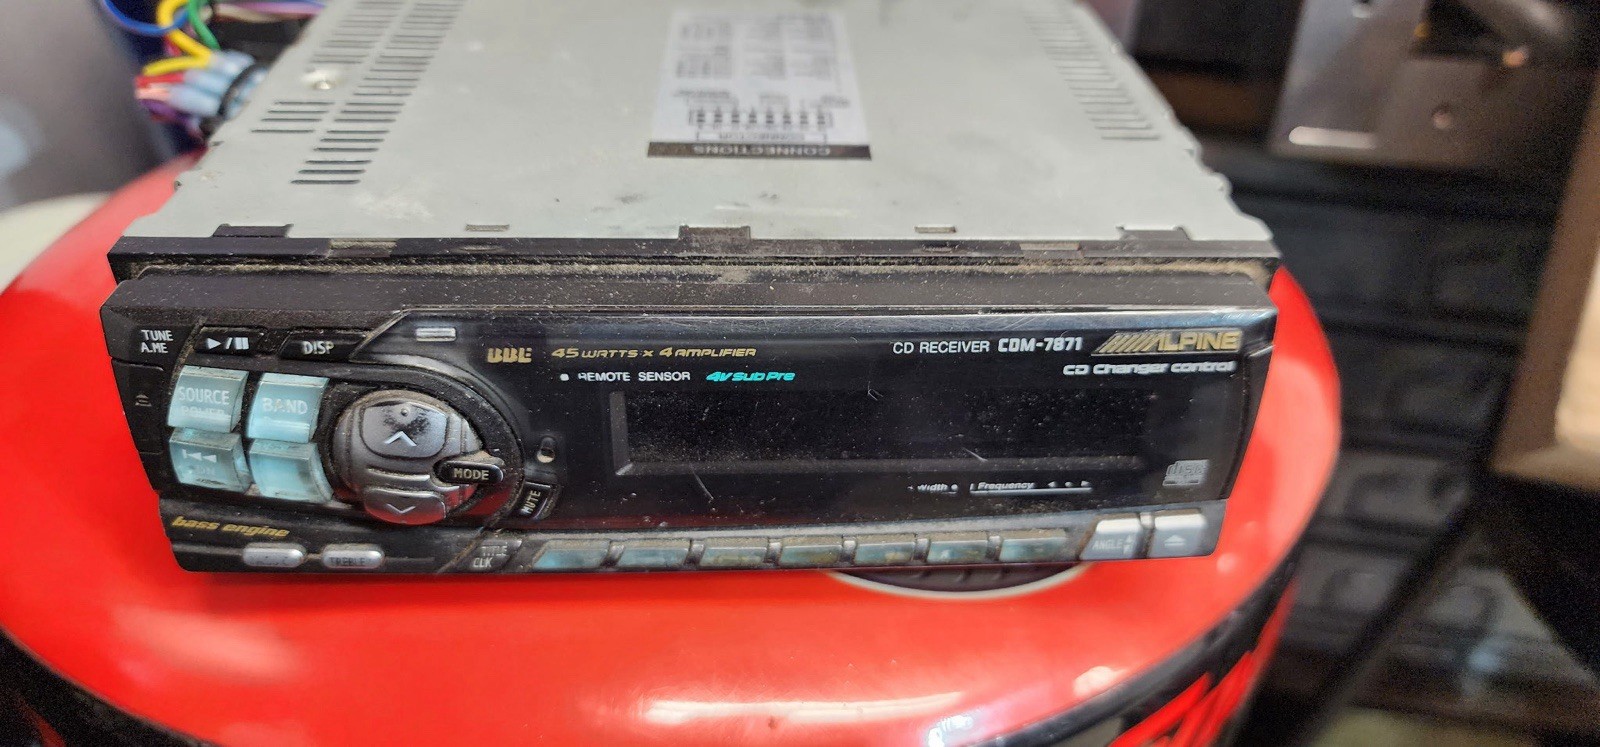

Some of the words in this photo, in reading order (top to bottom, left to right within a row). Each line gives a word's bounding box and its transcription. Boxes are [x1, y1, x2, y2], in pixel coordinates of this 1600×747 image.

[693, 144, 831, 157] CONNECTIONS
[141, 329, 174, 342] TUNE
[1140, 331, 1242, 353] ALPINE
[140, 341, 169, 354] A.ME
[302, 340, 335, 355] DISP
[892, 340, 914, 354] CD
[919, 340, 990, 354] RECEIVER
[997, 336, 1083, 353] CDM-7871
[551, 347, 580, 359] 45
[658, 347, 673, 358] 4
[674, 348, 757, 358] AMPLIFIER
[1062, 363, 1088, 376] CD
[1092, 361, 1168, 376] Changer
[1170, 359, 1236, 374] control
[577, 371, 631, 382] REMOTE
[638, 371, 691, 382] SENSOR
[178, 385, 230, 406] SOURCE
[262, 397, 308, 415] BAND
[453, 467, 490, 481] MODE
[977, 482, 1036, 491] Frequency
[522, 490, 541, 514] MUTE
[171, 516, 222, 531] bass
[221, 522, 291, 538] engine
[1092, 538, 1124, 551] ANGLE
[328, 556, 366, 568] TREBLE
[472, 557, 494, 569] CLK
